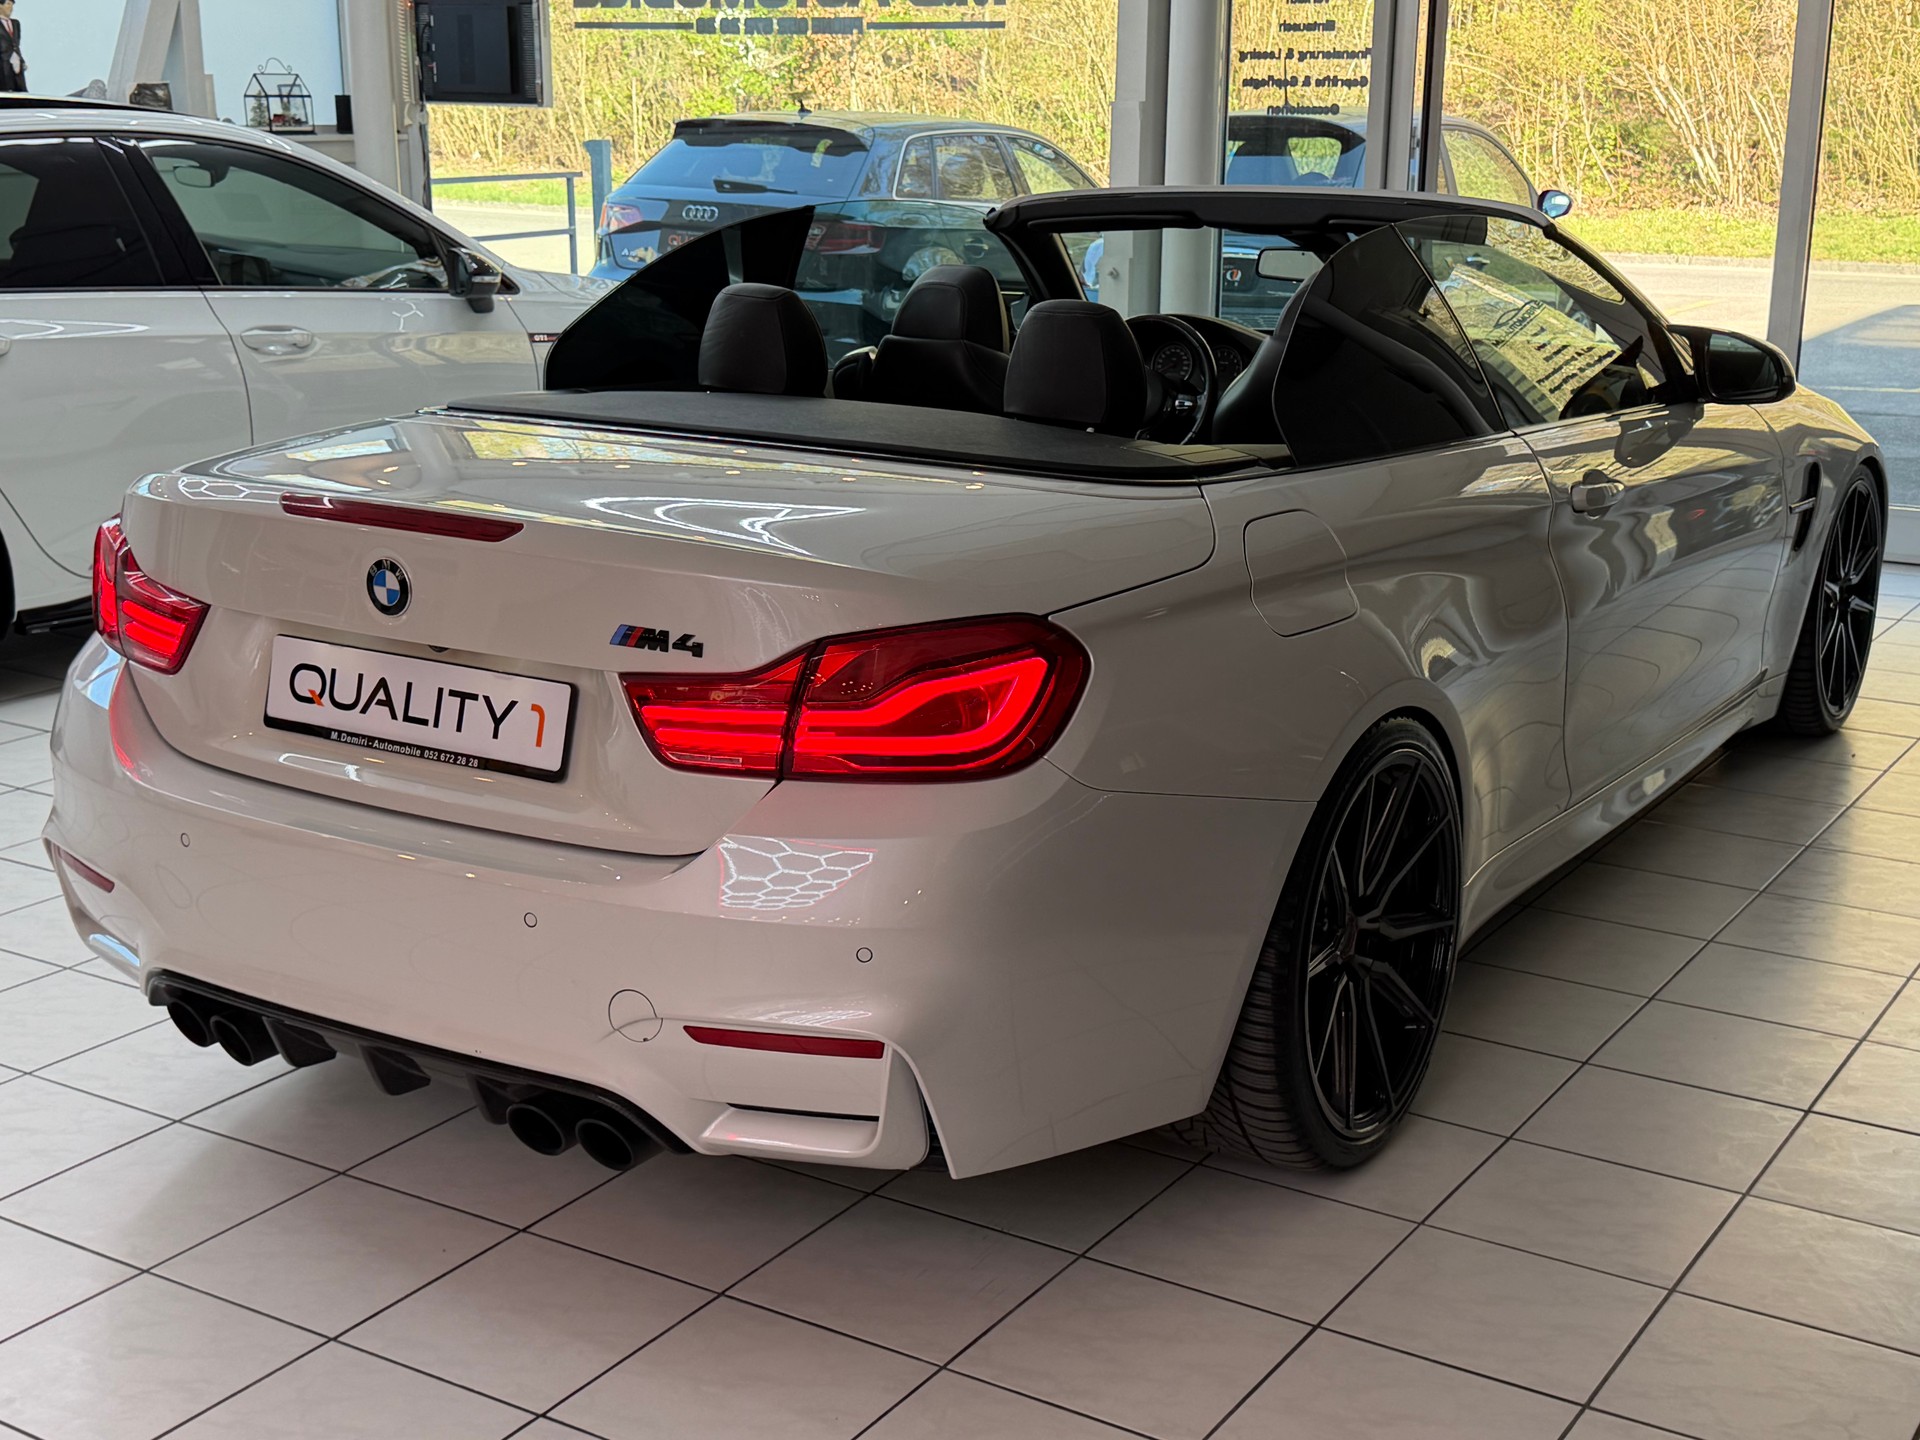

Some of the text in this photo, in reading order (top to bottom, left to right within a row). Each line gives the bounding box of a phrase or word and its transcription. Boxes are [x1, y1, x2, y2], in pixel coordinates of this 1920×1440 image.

[369, 559, 405, 581] BMW
[289, 663, 519, 739] QUALITY
[373, 740, 421, 757] Automobile
[424, 752, 438, 761] 052
[440, 754, 455, 764] 672
[457, 756, 467, 766] 28
[468, 758, 479, 768] 28
